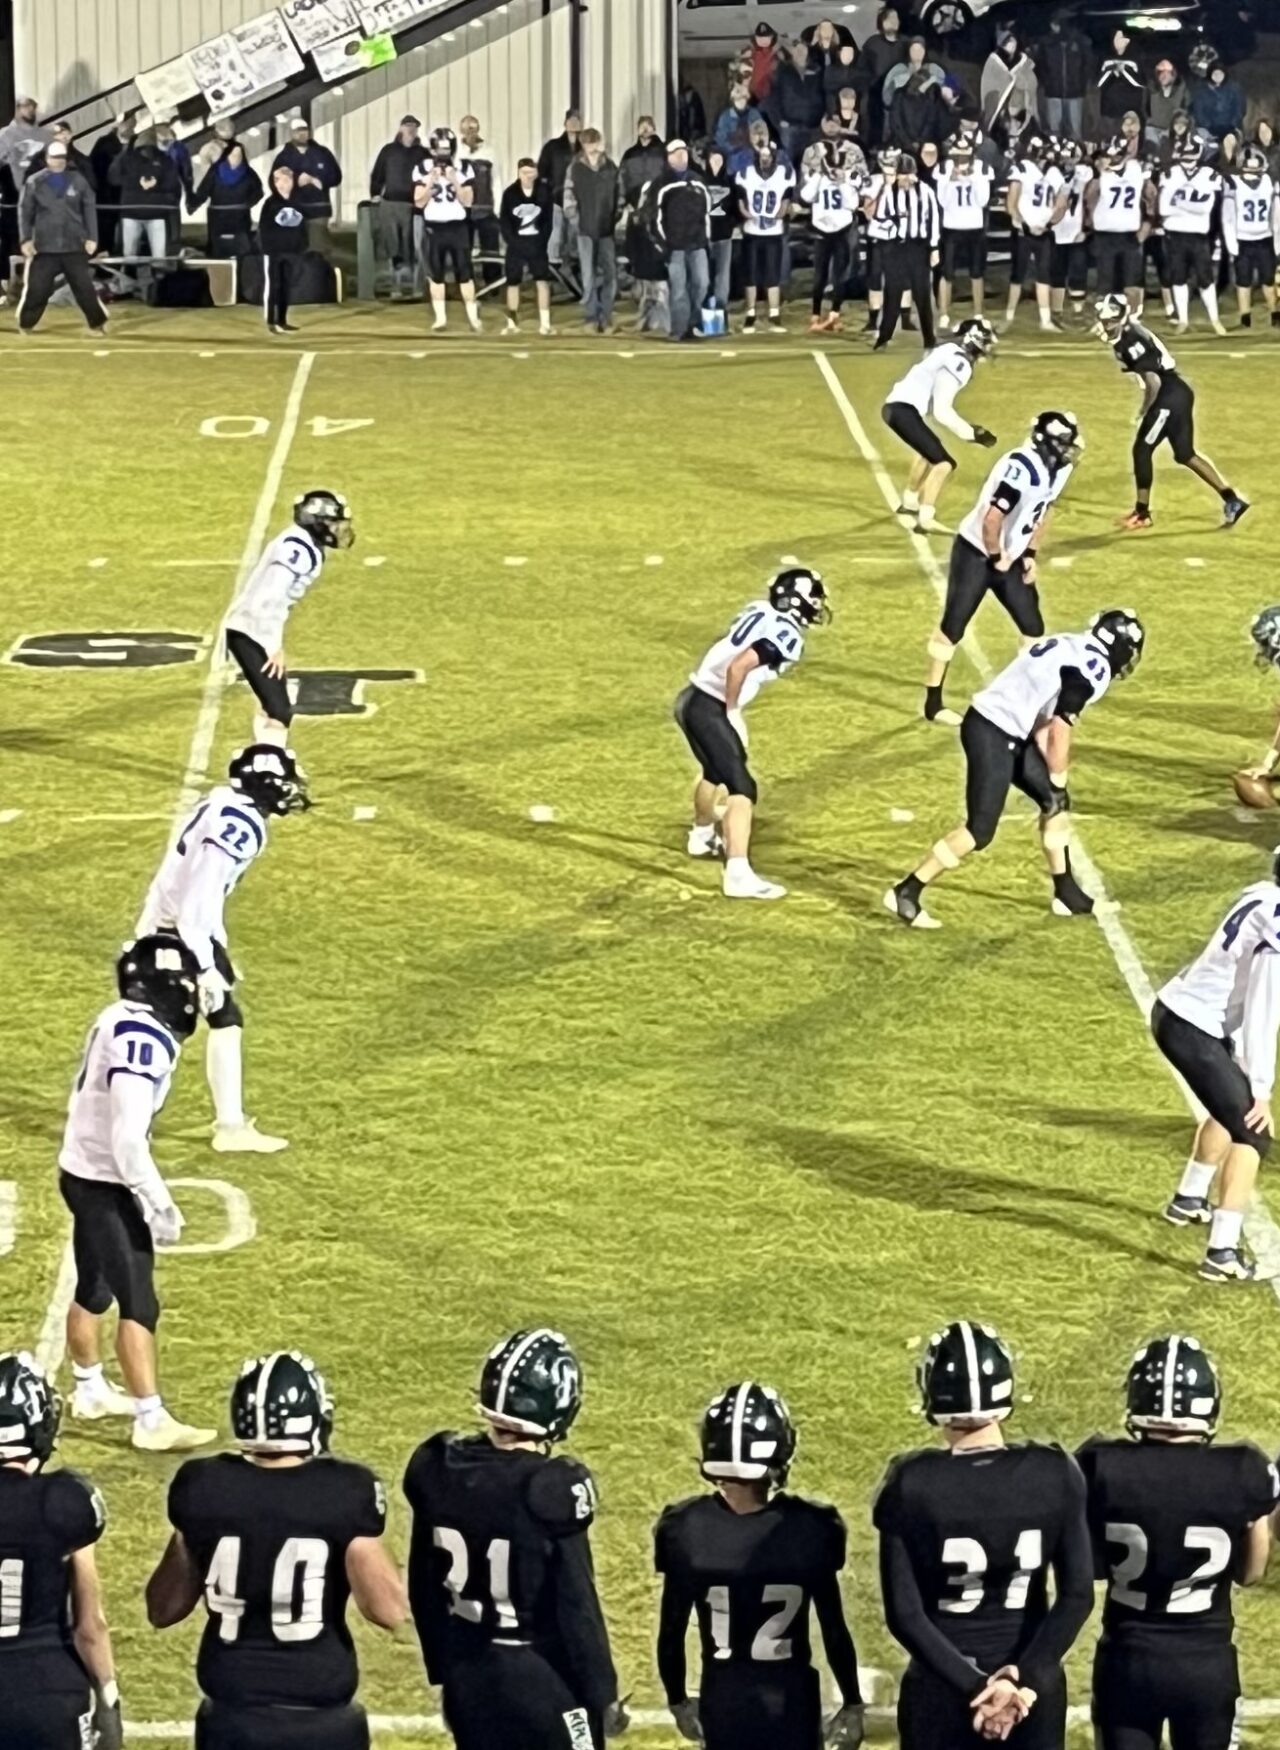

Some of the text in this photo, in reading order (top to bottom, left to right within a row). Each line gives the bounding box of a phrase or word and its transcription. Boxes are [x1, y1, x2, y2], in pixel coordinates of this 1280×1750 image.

[1109, 186, 1136, 209] 72
[1243, 199, 1268, 222] 32
[220, 823, 250, 852] 22
[127, 1039, 154, 1066] 10
[204, 1535, 330, 1642] 40
[432, 1526, 519, 1628] 21
[937, 1528, 1042, 1614] 31
[1105, 1522, 1232, 1613] 22
[705, 1583, 804, 1661] 12
